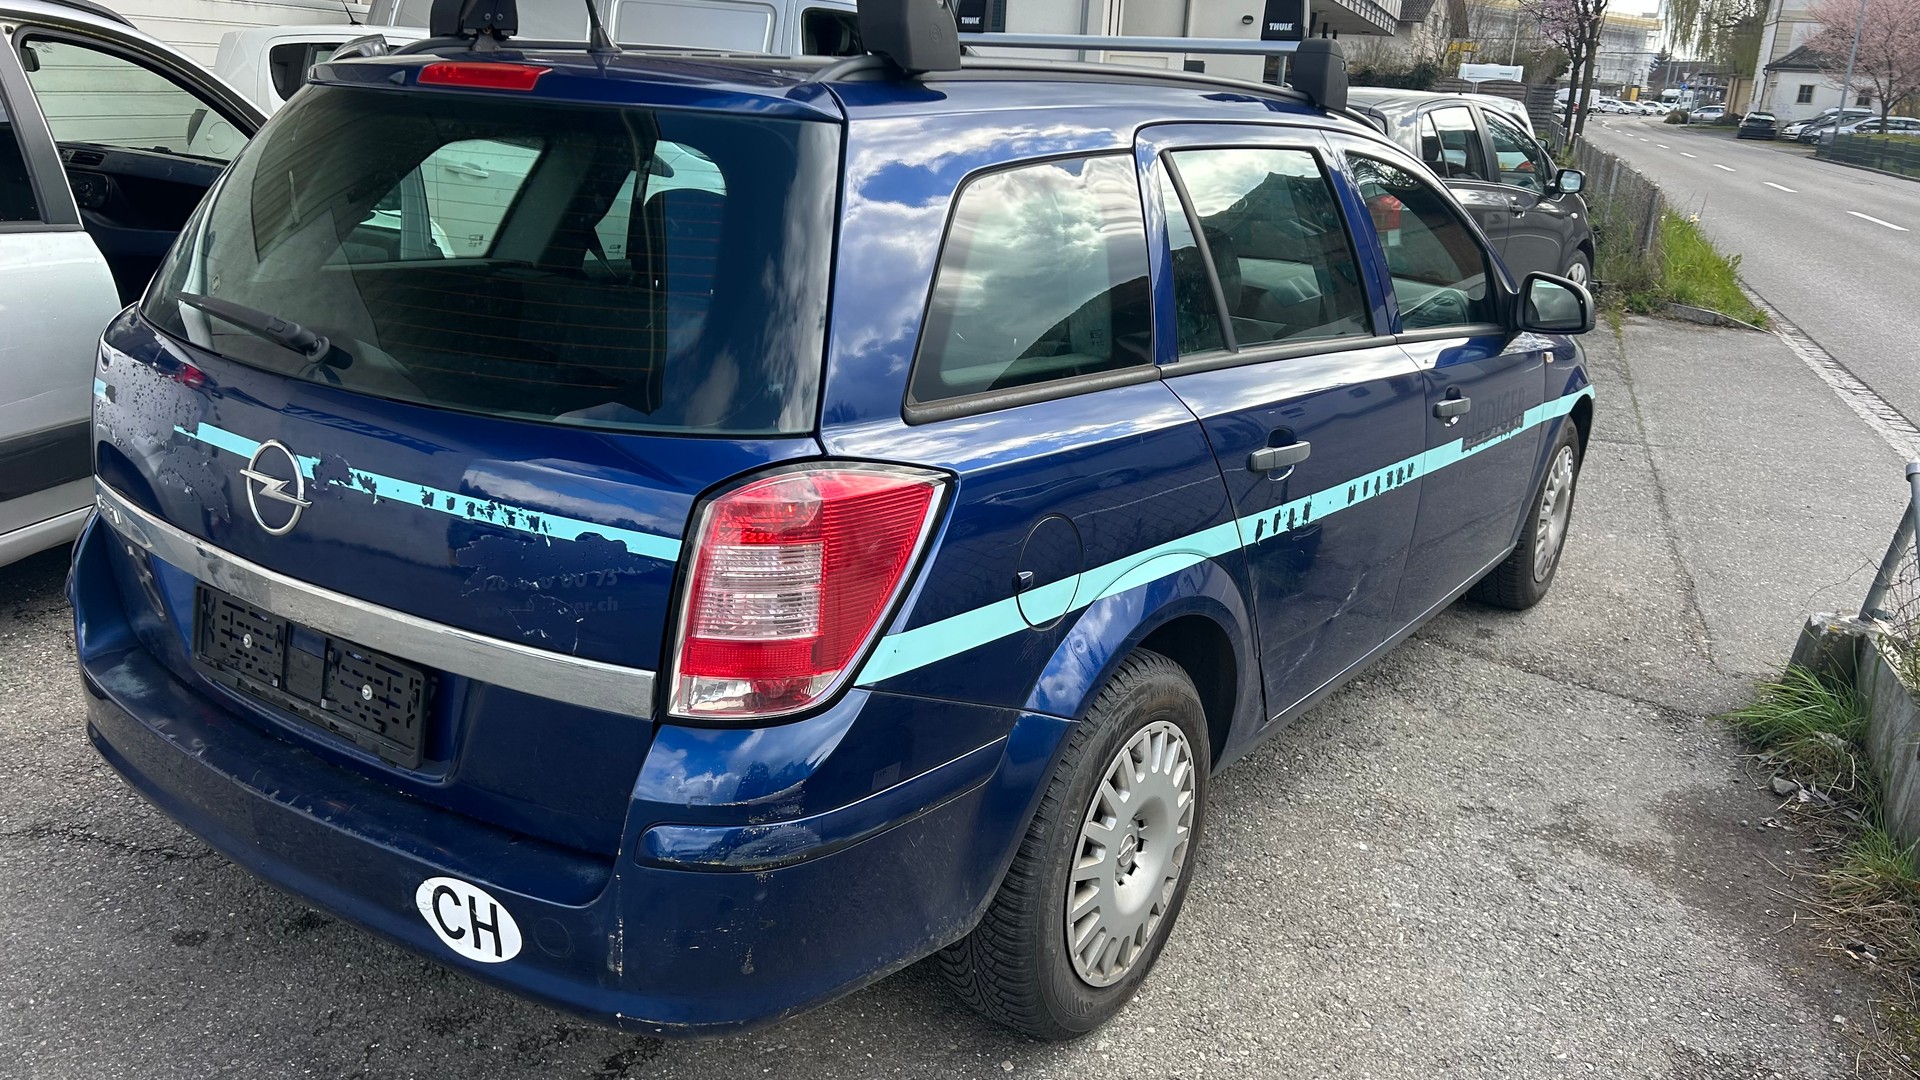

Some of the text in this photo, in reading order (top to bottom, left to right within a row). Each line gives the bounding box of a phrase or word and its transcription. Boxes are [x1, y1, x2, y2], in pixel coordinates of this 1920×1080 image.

[961, 16, 980, 24] THULE
[1269, 23, 1293, 31] THULE
[432, 885, 502, 958] CH
